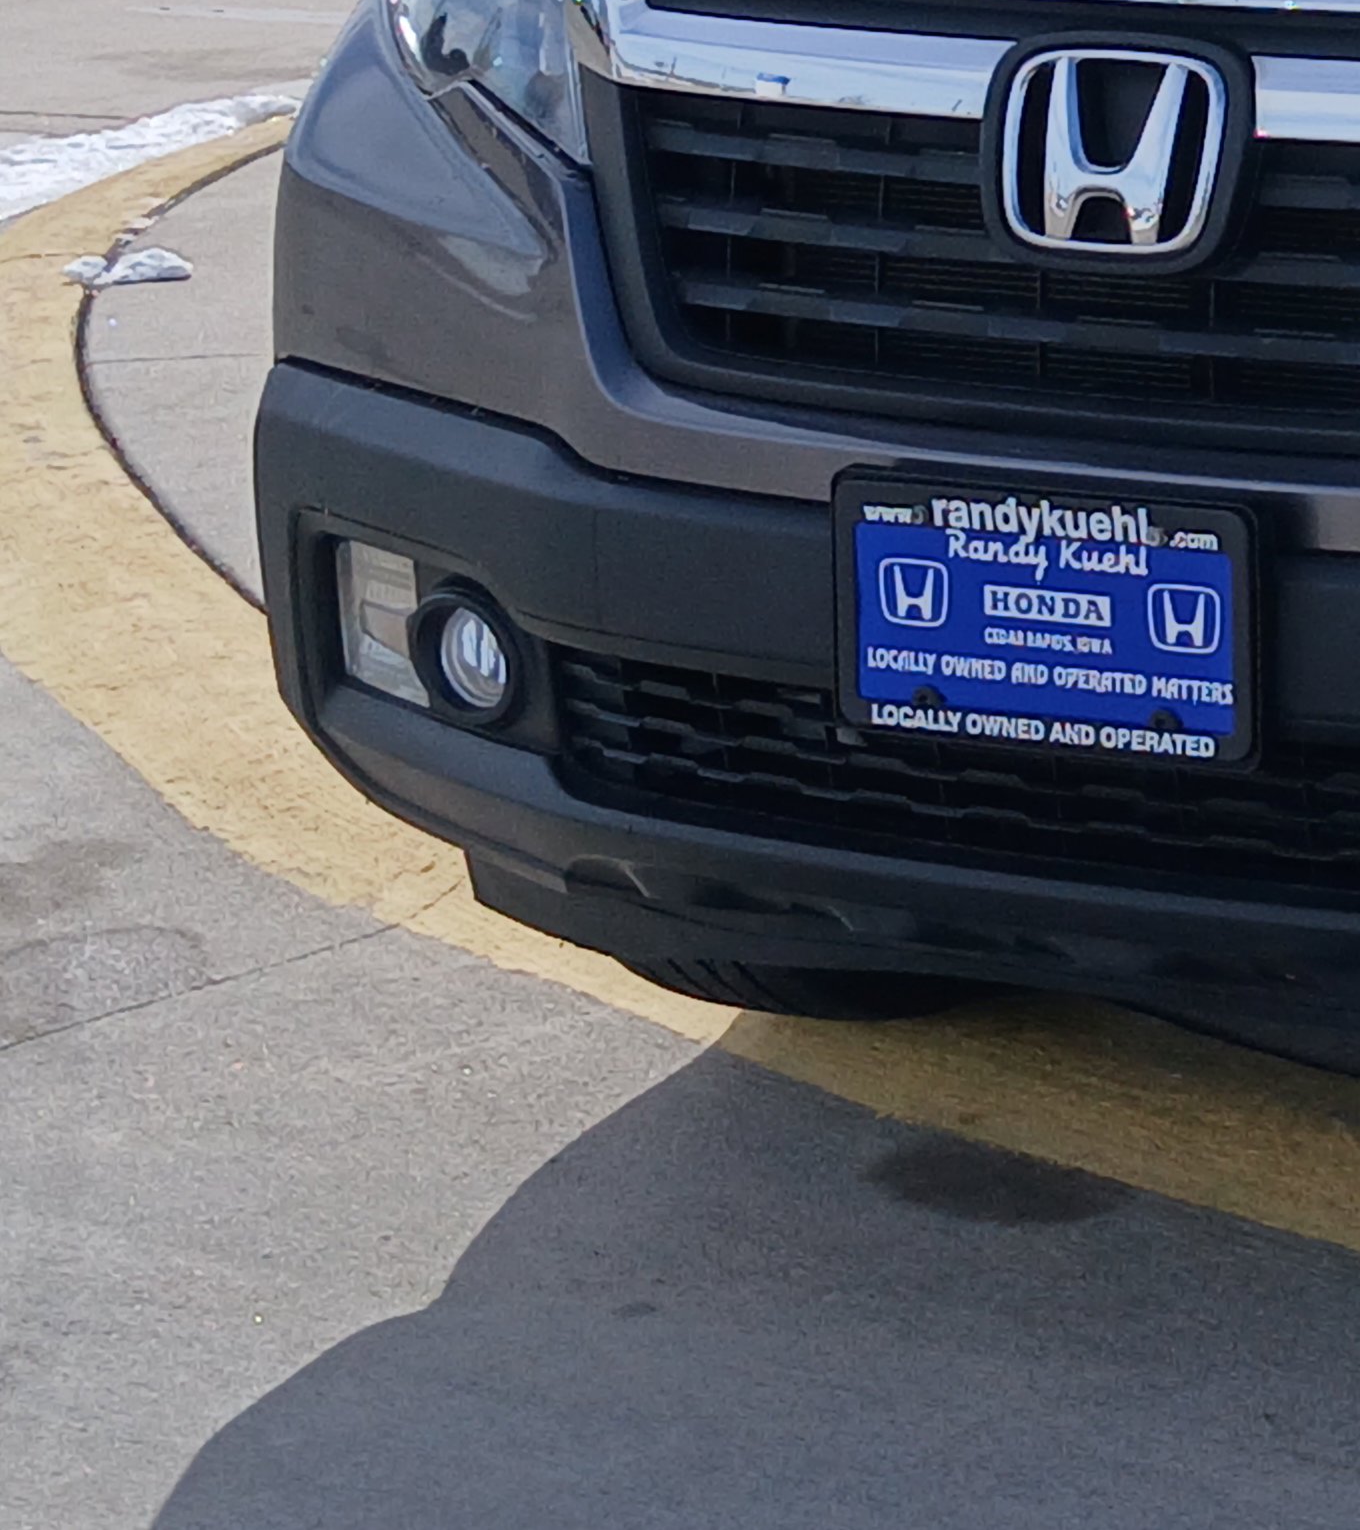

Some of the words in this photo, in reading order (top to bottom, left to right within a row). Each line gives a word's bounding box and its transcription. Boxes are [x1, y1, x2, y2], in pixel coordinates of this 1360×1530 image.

[931, 497, 1151, 545] randykuehl
[945, 528, 1048, 581] Randy
[1059, 539, 1148, 576] Kuehl
[990, 590, 1105, 621] HONDA
[867, 646, 937, 675] LOCALLY
[941, 654, 1006, 680] OWNED
[1011, 661, 1048, 685] AND
[1053, 666, 1147, 695] OPERATED
[1152, 676, 1234, 705] MATTERS
[871, 703, 962, 733] LOCALLY
[966, 713, 1045, 741] OWNED
[1049, 722, 1096, 747] AND
[1100, 726, 1215, 758] OPERATED
